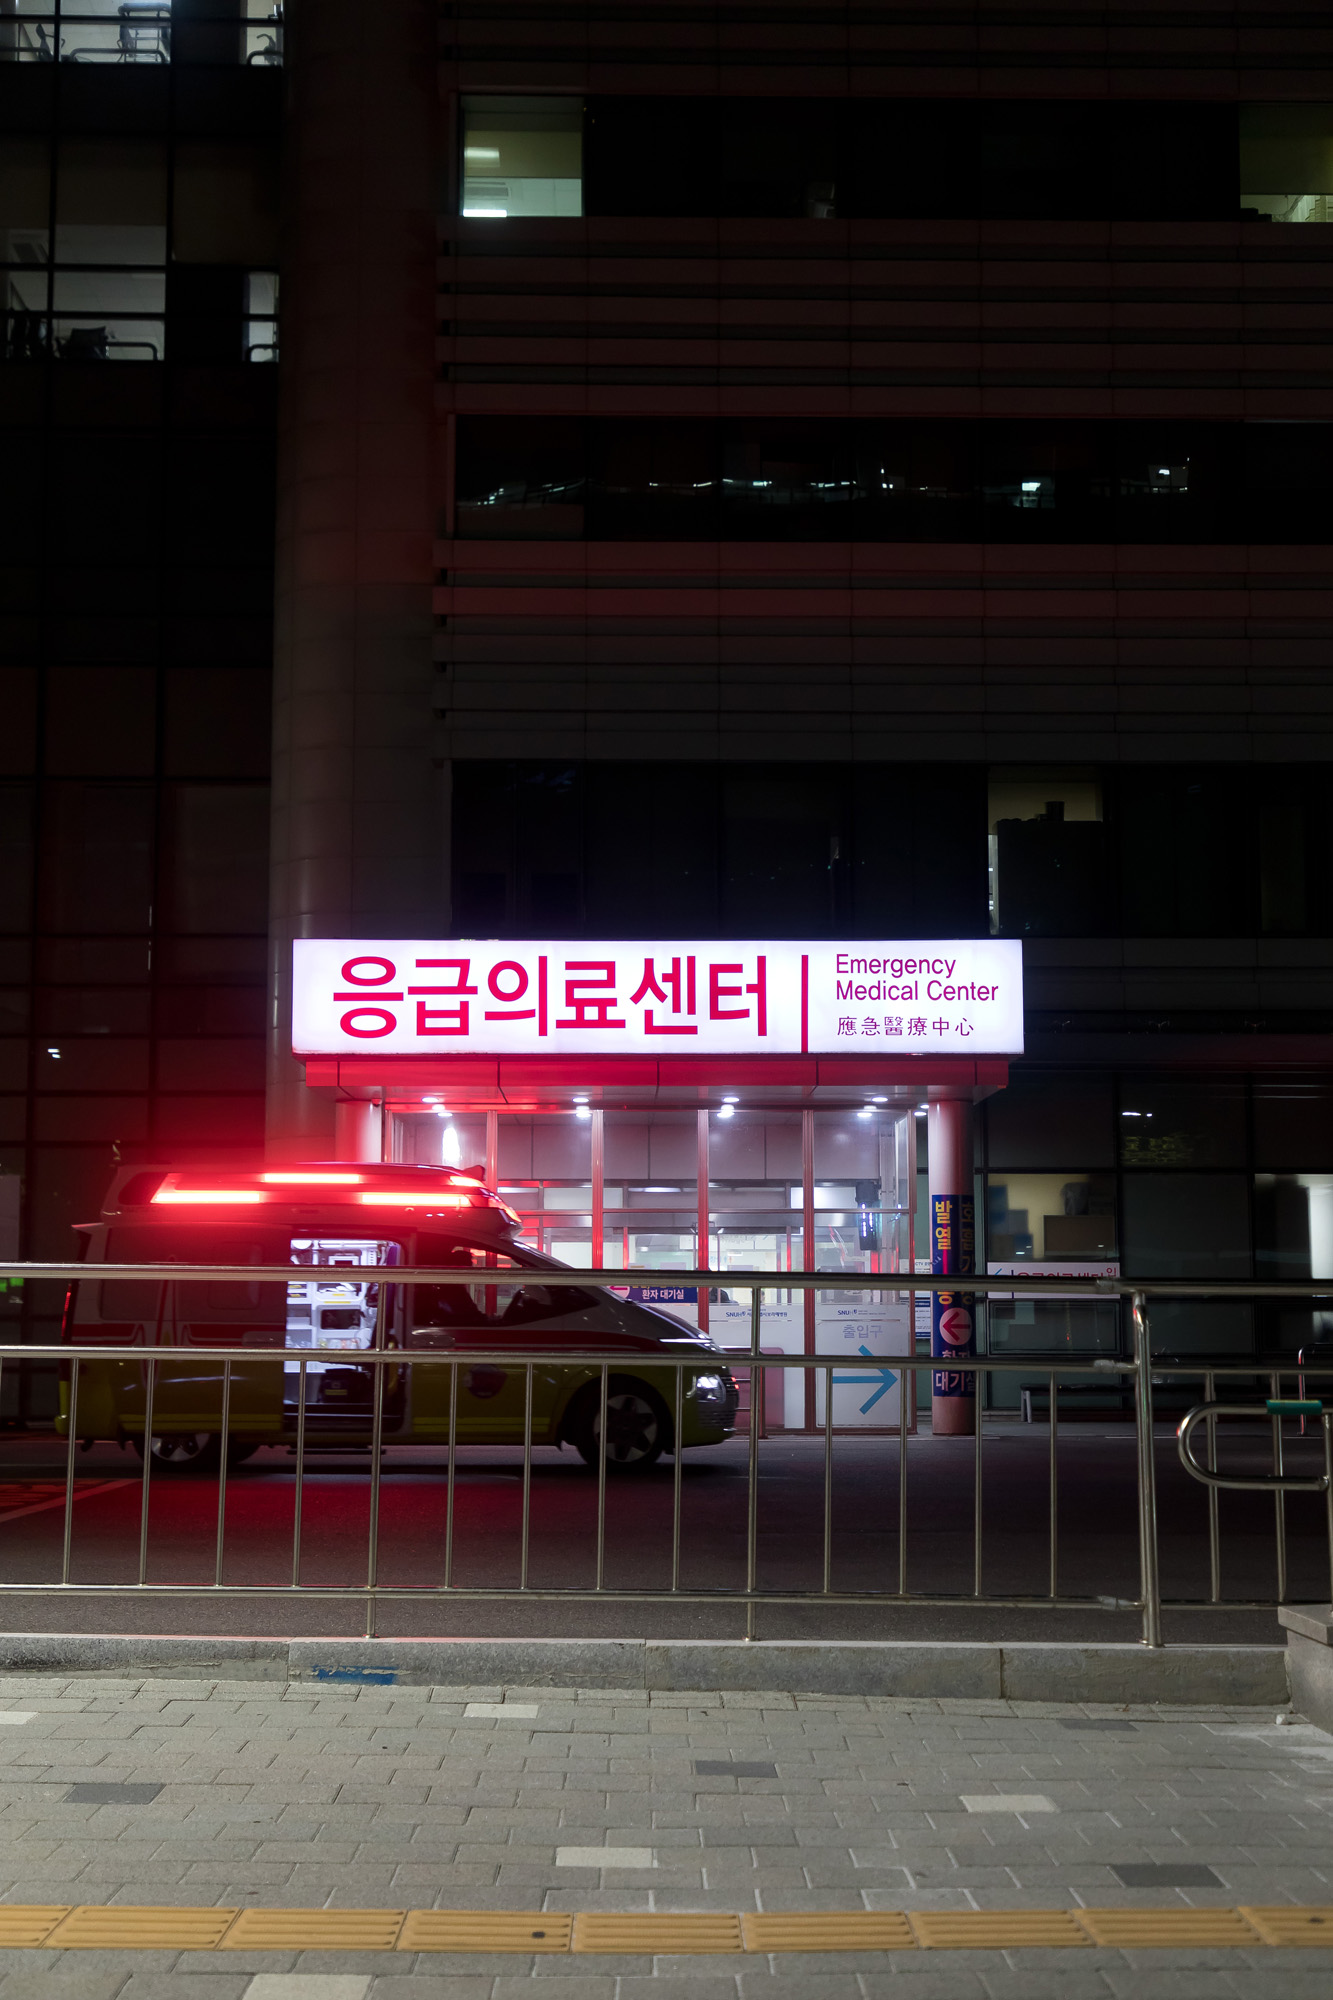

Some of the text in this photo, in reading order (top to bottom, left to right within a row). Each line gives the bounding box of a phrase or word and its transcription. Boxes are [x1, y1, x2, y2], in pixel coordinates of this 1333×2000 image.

[837, 954, 956, 978] Emergency
[333, 956, 767, 1038] 응급의료센터
[837, 979, 999, 1002] Medical Center
[838, 1016, 974, 1036] 應急醫療中心
[935, 1200, 953, 1250] 발열
[641, 1289, 684, 1300] 환자 대기실
[843, 1325, 883, 1339] 출입구
